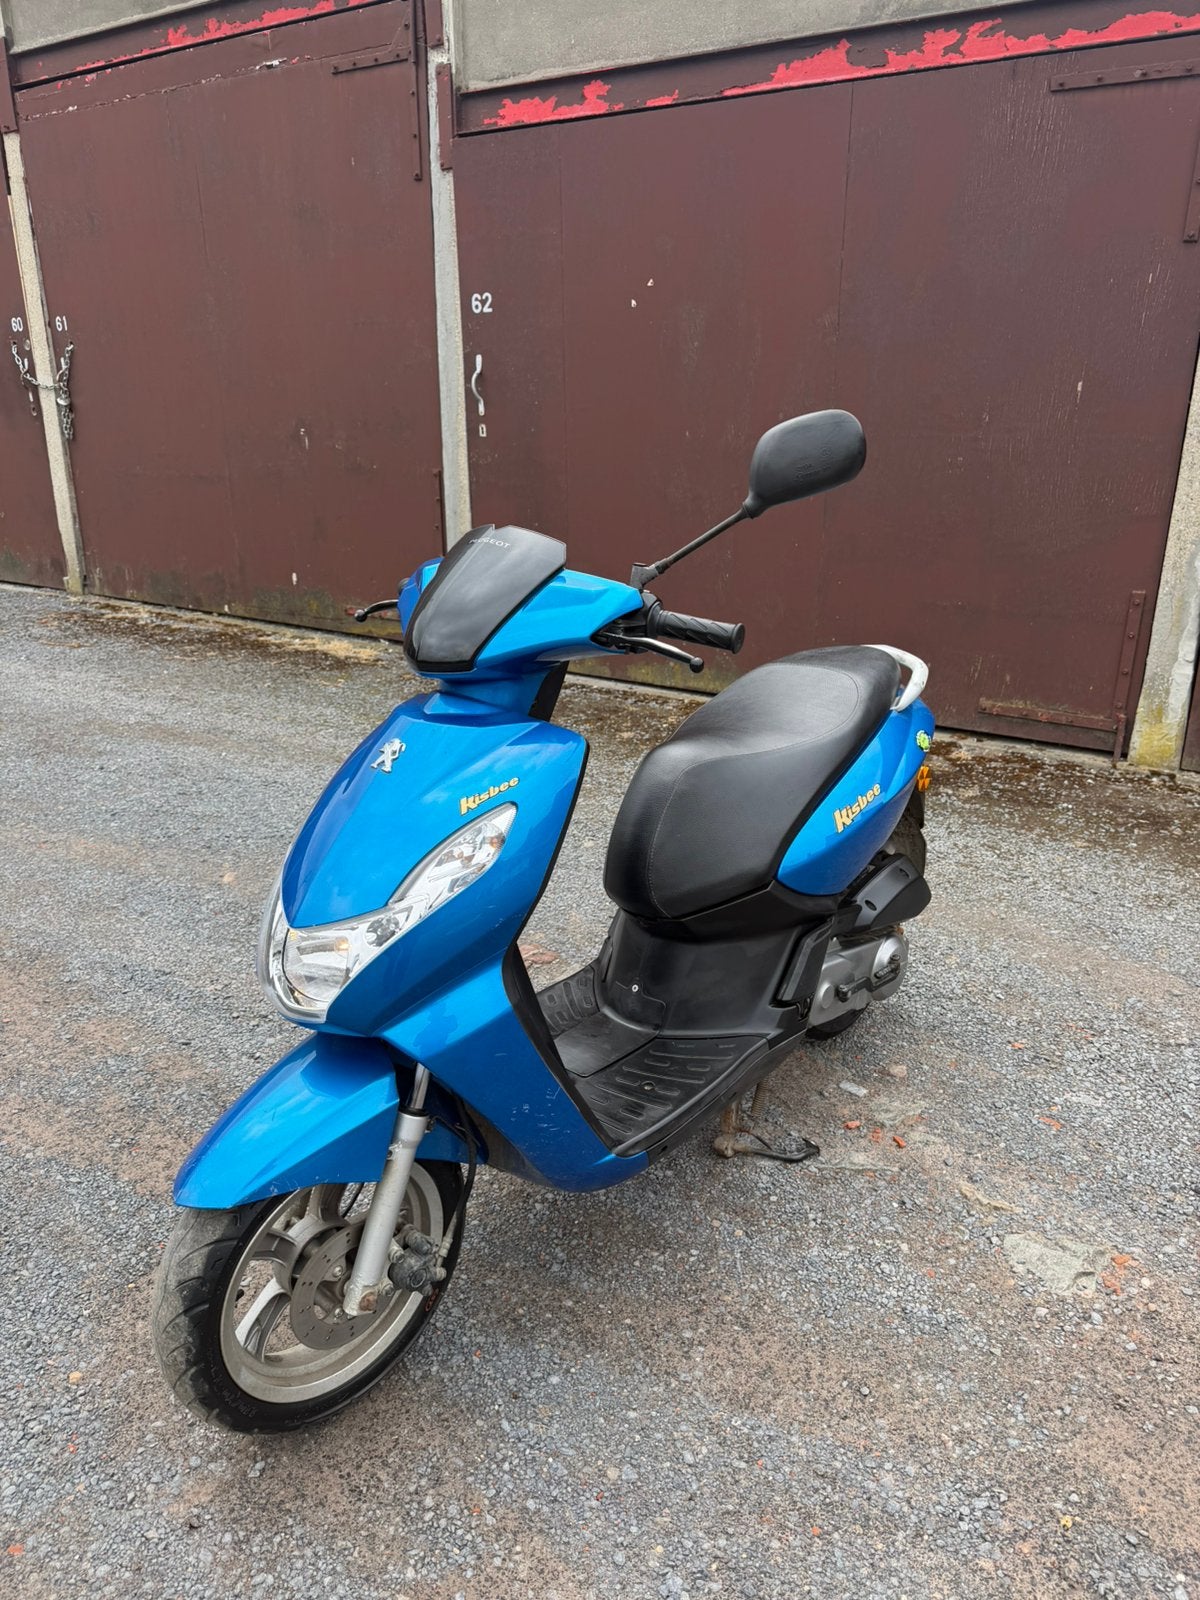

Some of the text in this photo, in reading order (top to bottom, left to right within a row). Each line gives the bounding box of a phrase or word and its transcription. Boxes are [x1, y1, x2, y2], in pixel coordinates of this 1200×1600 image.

[471, 292, 493, 314] 62
[11, 316, 24, 332] 60
[55, 315, 68, 332] 61
[459, 776, 519, 816] Kisbee
[833, 783, 881, 833] Kisbee
